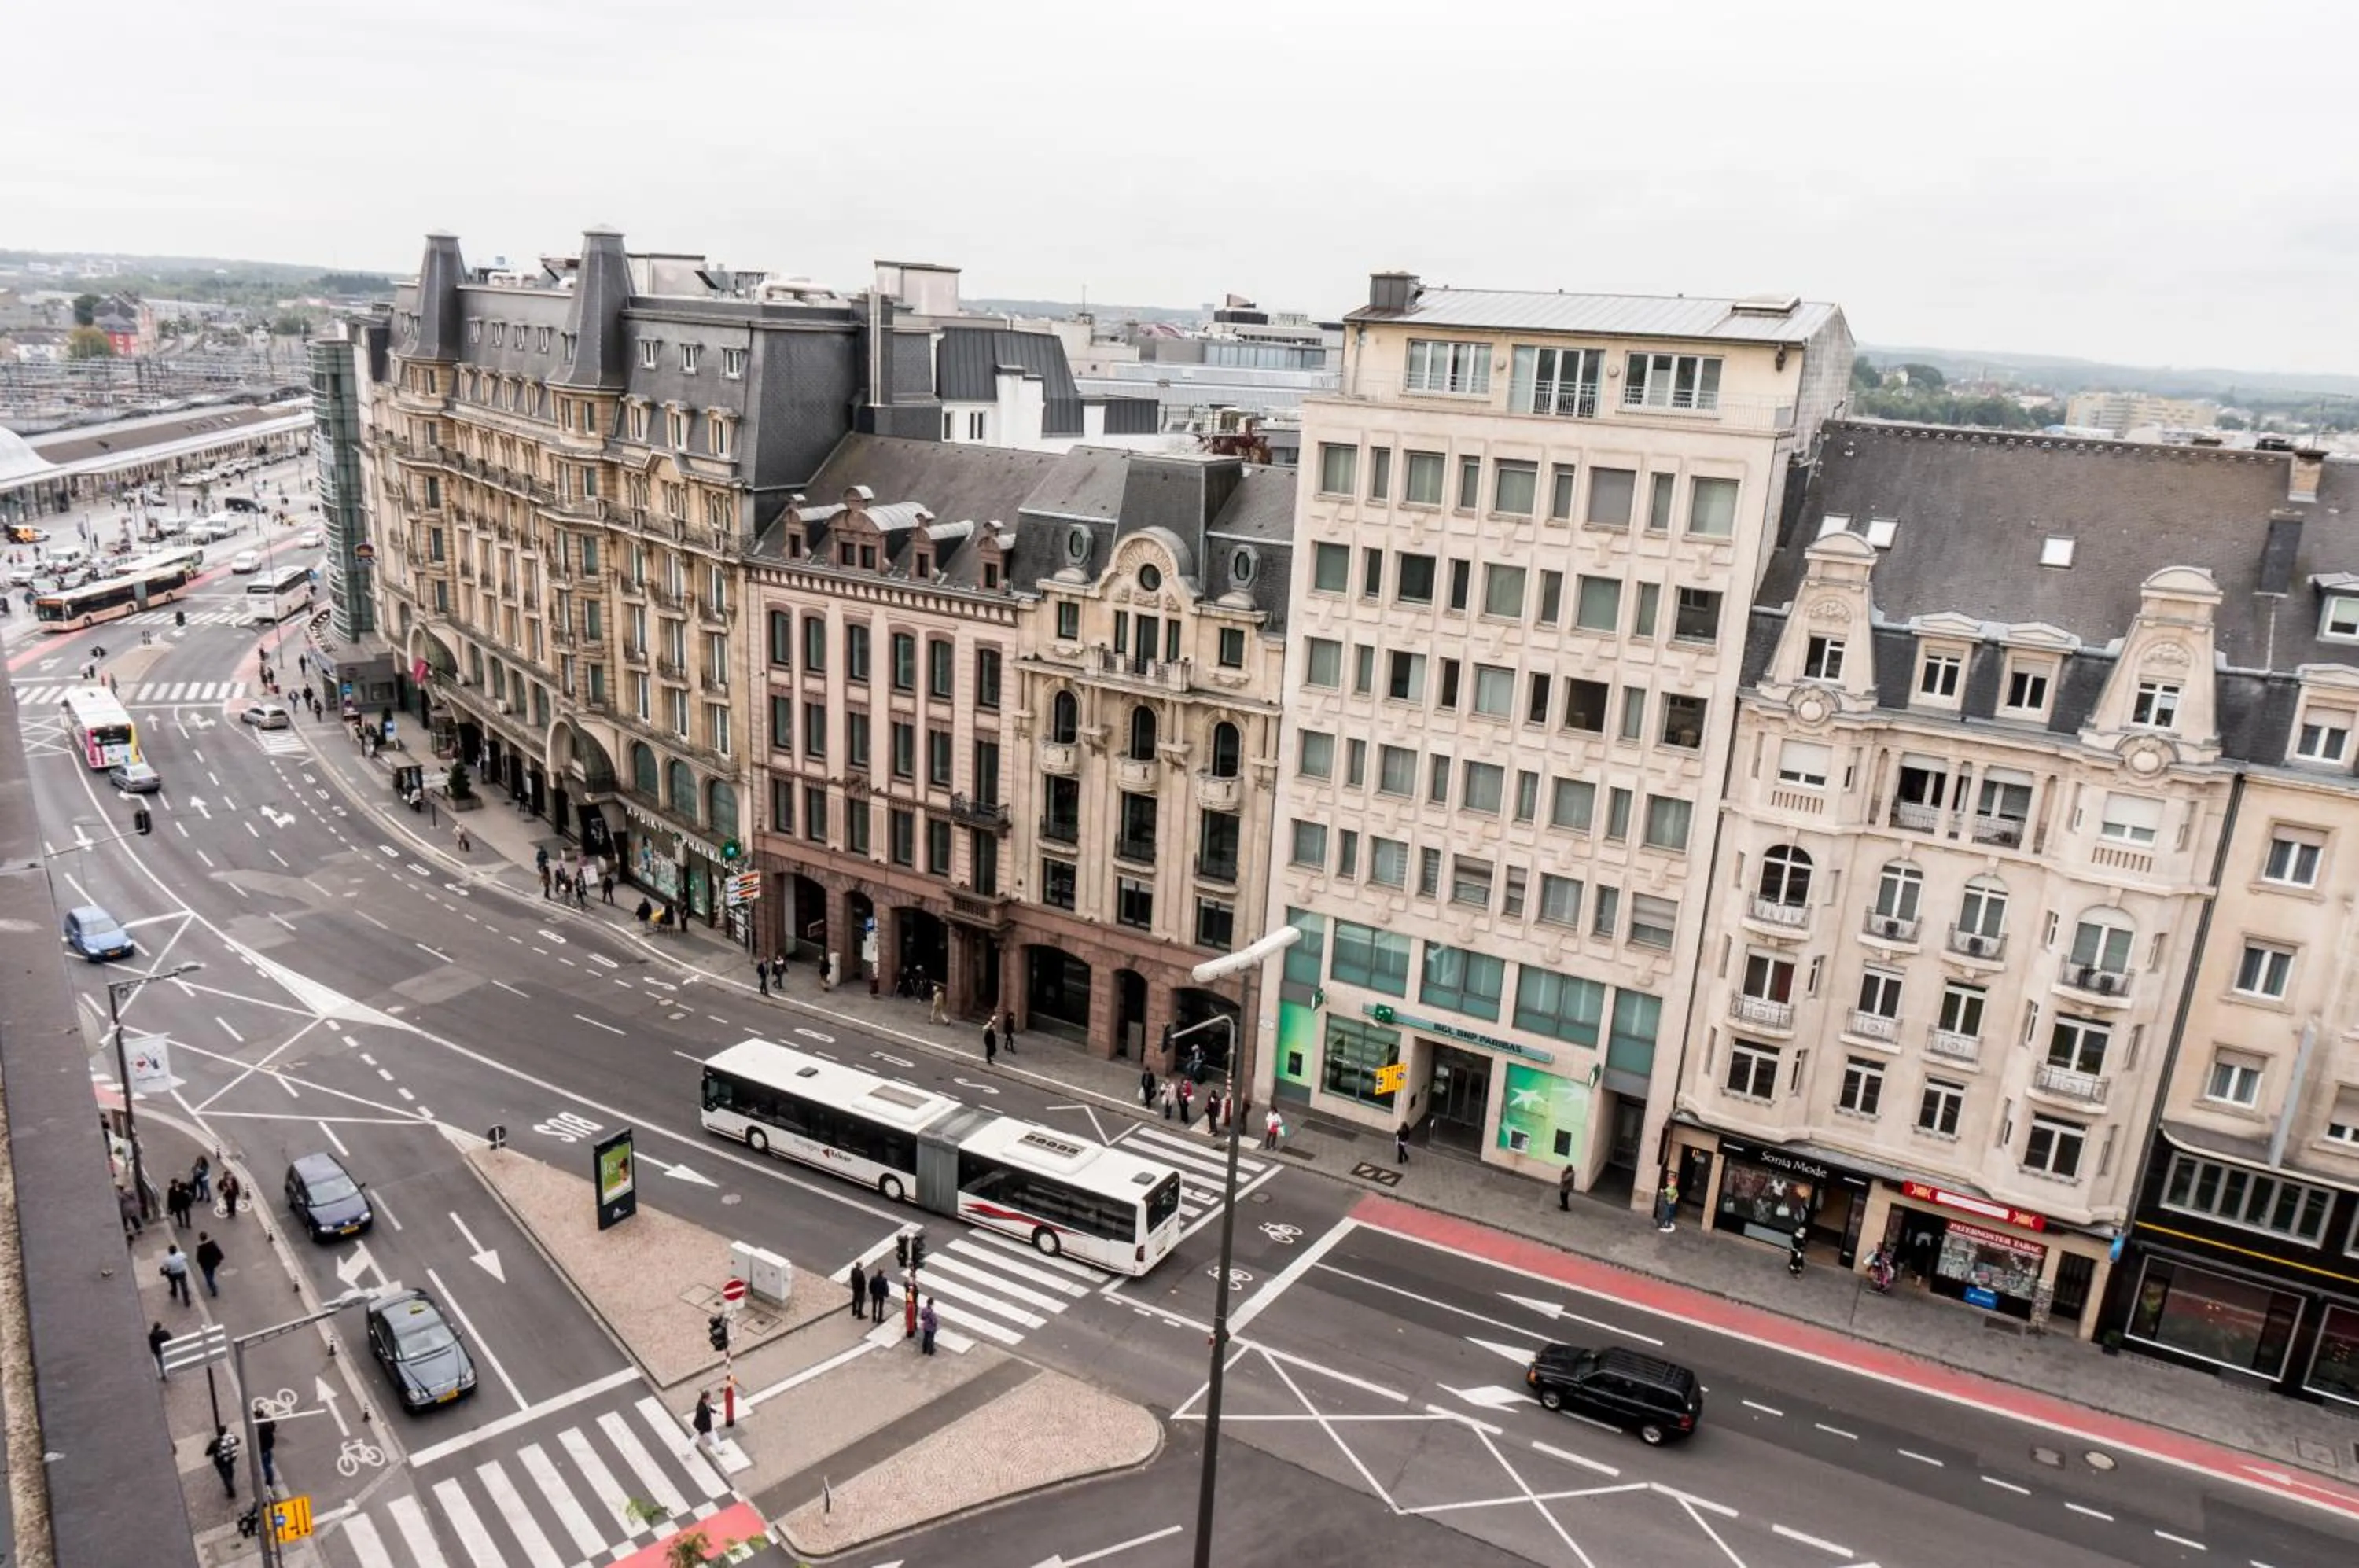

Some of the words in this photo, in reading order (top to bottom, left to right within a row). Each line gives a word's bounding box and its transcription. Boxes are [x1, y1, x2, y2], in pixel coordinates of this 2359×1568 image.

[538, 929, 678, 991] BUS
[1433, 1023, 1453, 1036] BGL
[1456, 1029, 1478, 1041] BNP
[1479, 1035, 1522, 1054] PARIBAS
[794, 1028, 1000, 1094] BUS
[532, 1111, 604, 1142] BUS
[1761, 1150, 1791, 1169] Sonia
[1794, 1160, 1828, 1178] Mode
[2013, 1239, 2043, 1253] TABAC
